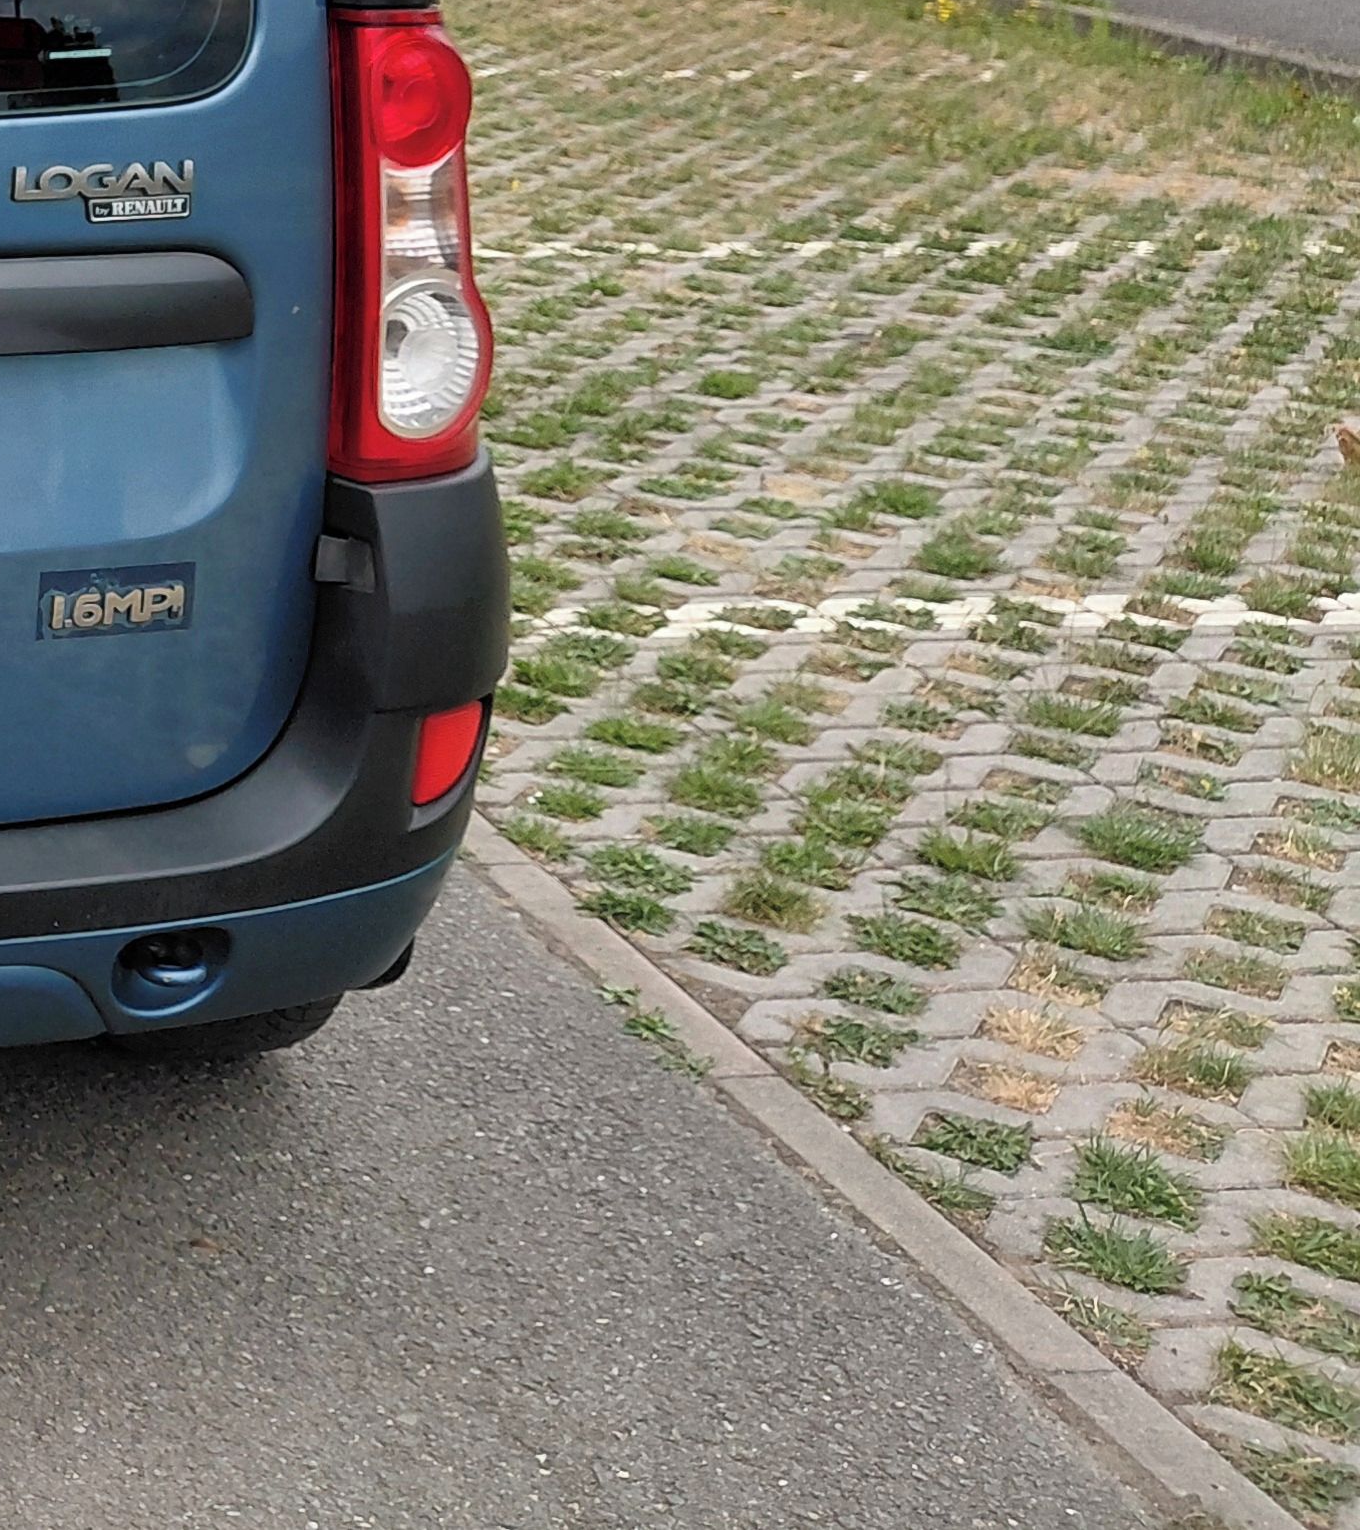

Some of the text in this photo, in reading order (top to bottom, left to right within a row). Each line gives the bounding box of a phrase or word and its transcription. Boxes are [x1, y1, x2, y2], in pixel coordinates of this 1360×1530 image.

[11, 159, 195, 202] LOGAN
[95, 198, 186, 216] by RENAULT
